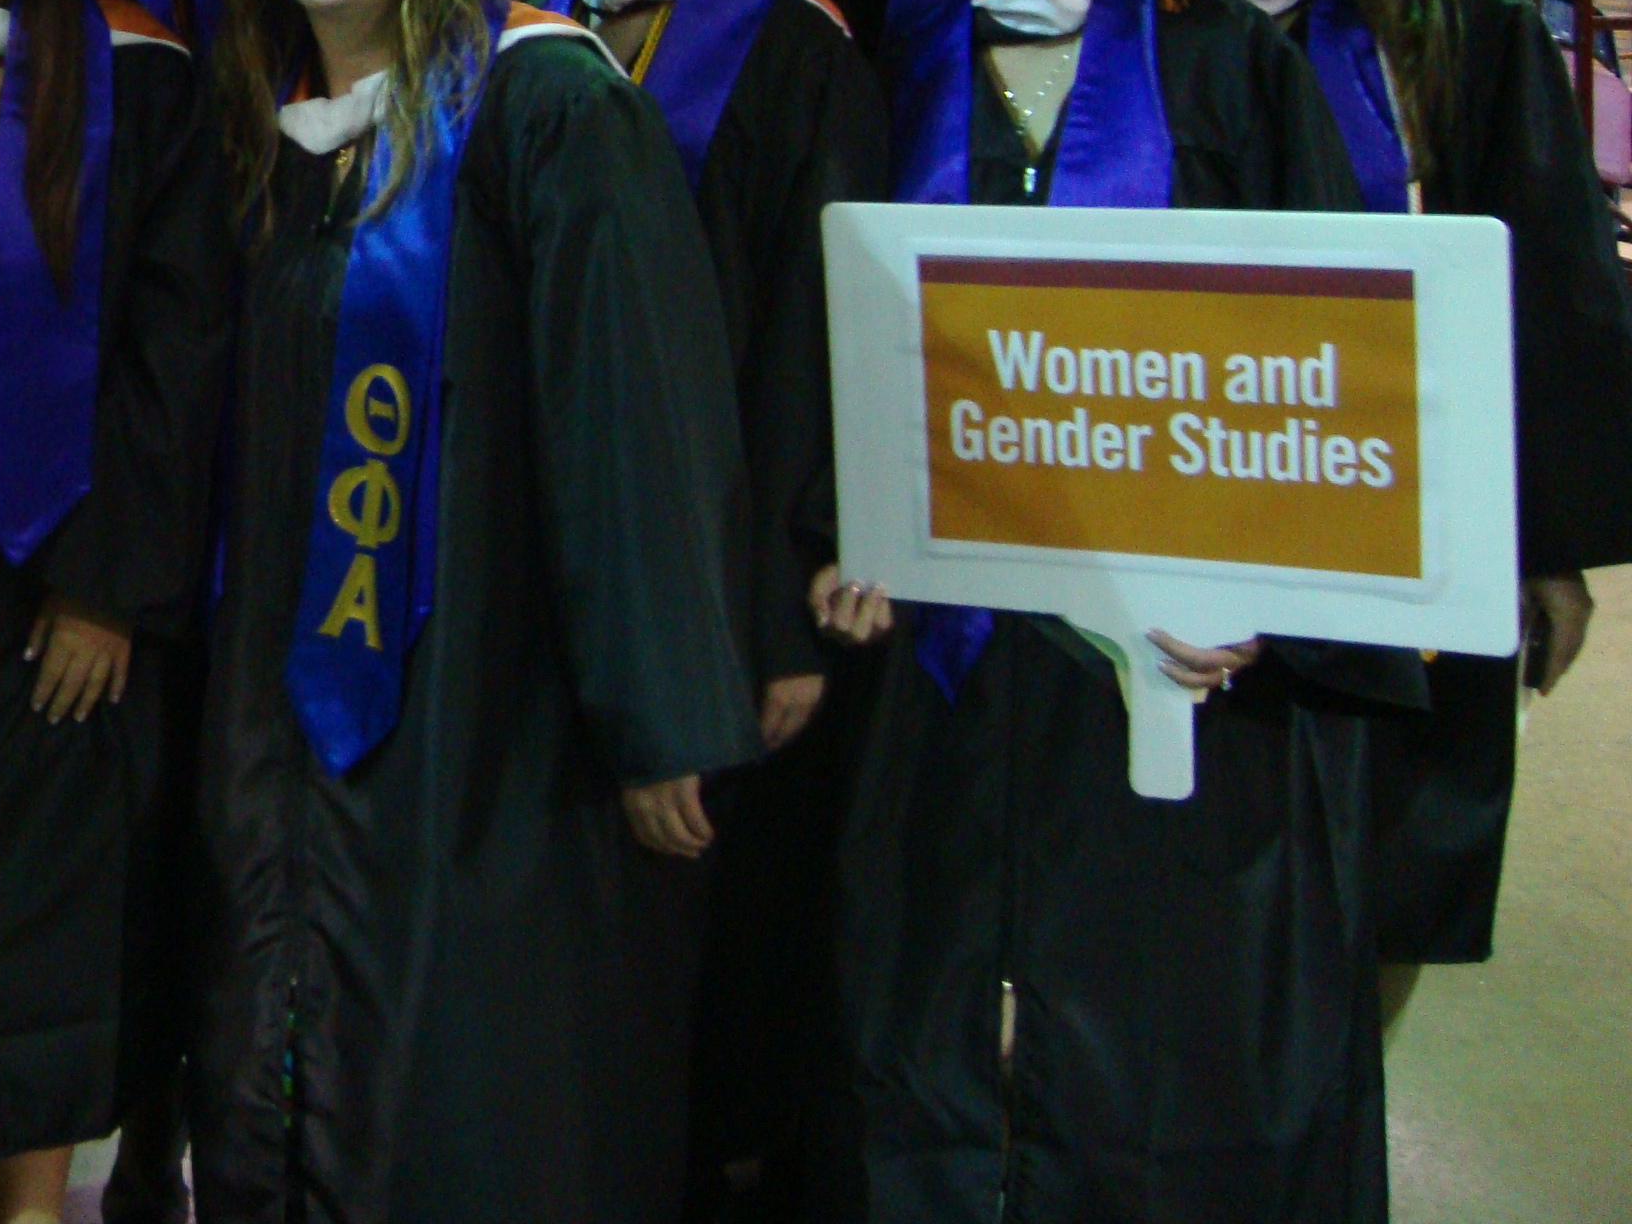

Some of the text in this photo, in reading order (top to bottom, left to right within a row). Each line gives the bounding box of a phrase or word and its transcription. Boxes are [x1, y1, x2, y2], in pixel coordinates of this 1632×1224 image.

[986, 328, 1338, 408] Women and
[950, 399, 1394, 489] Gender Studies
